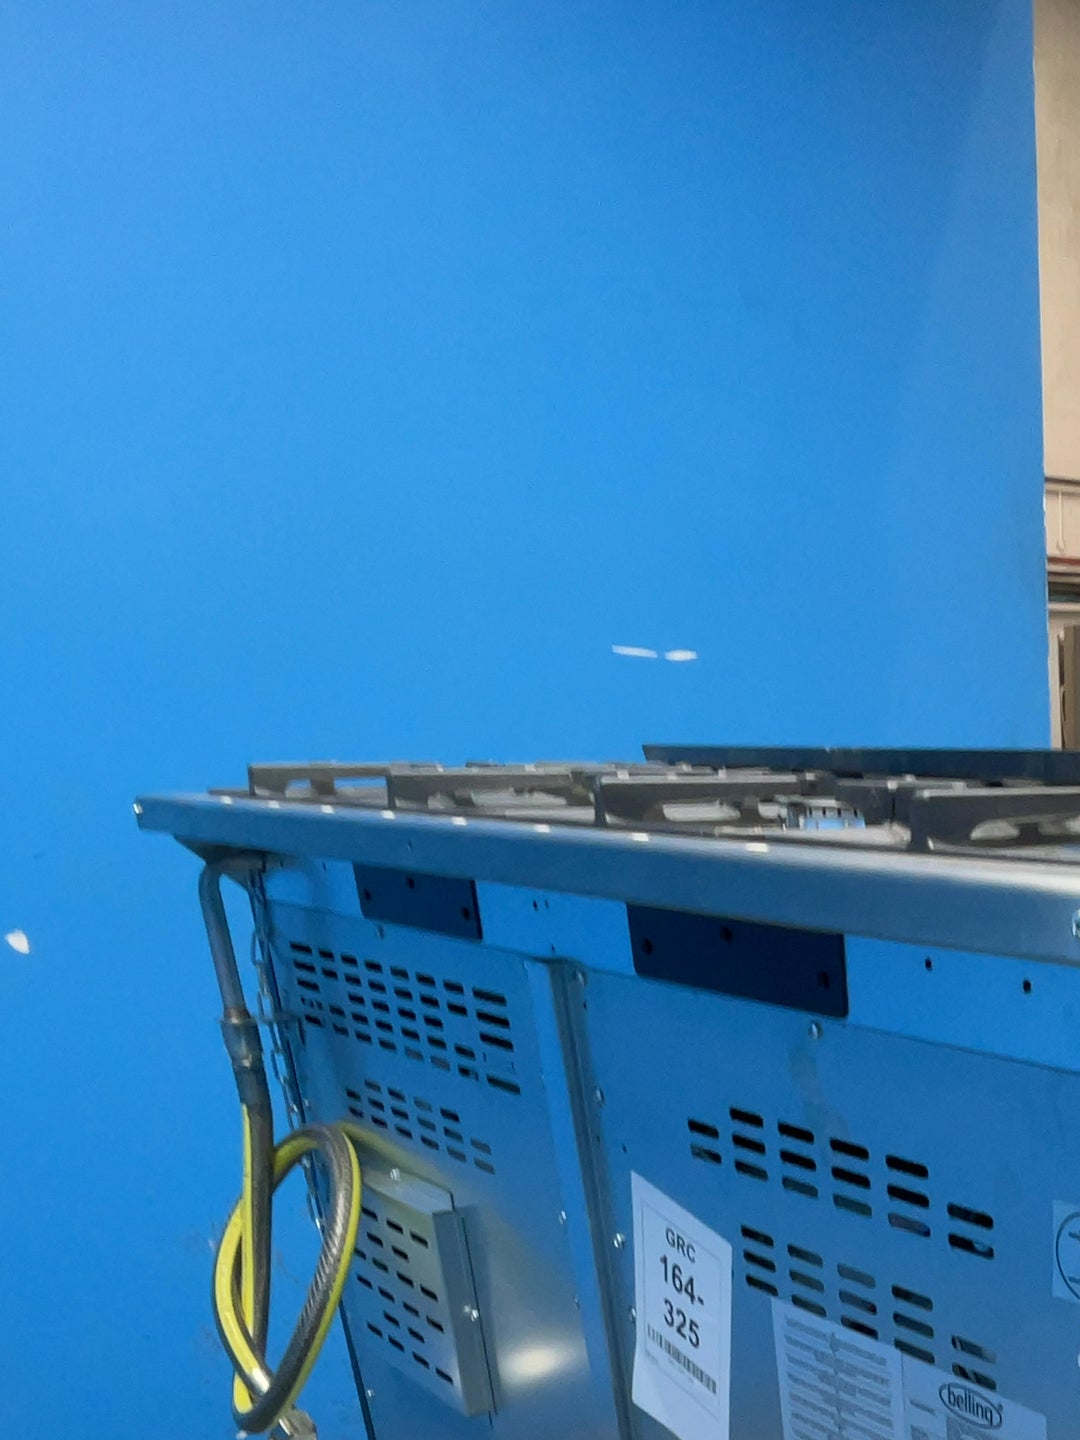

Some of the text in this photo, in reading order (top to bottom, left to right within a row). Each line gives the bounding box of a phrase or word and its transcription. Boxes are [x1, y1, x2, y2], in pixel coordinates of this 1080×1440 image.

[665, 1227, 696, 1264] GRC
[660, 1254, 704, 1305] 164-
[664, 1297, 700, 1349] 325
